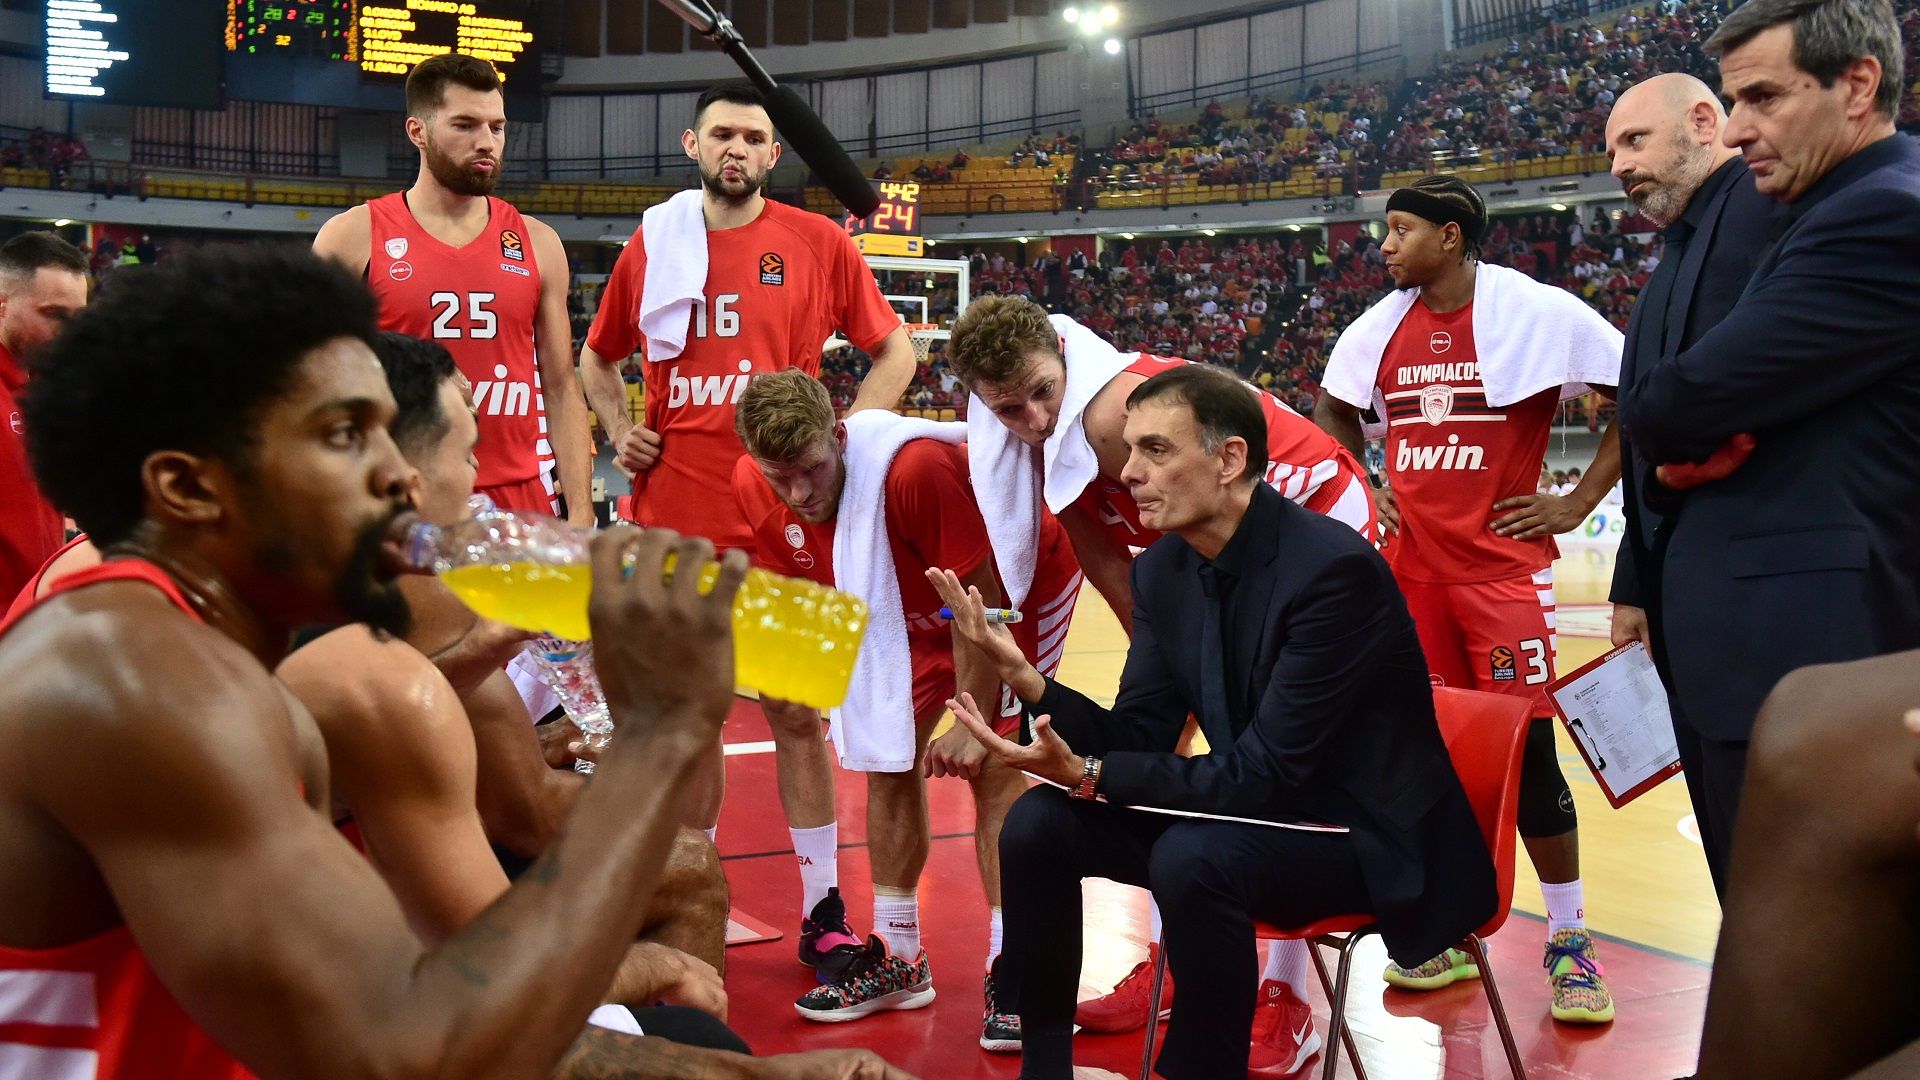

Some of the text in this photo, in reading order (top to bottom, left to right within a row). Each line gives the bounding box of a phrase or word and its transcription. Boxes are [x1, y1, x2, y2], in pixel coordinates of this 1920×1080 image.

[873, 203, 914, 231] 24
[430, 291, 498, 339] 25
[694, 294, 740, 338] 16
[668, 359, 752, 409] bwi
[1398, 361, 1482, 385] OLYMPIACOS
[1396, 434, 1484, 472] bwin
[1519, 638, 1549, 685] 3
[1604, 640, 1640, 662] OLYMPIACOS
